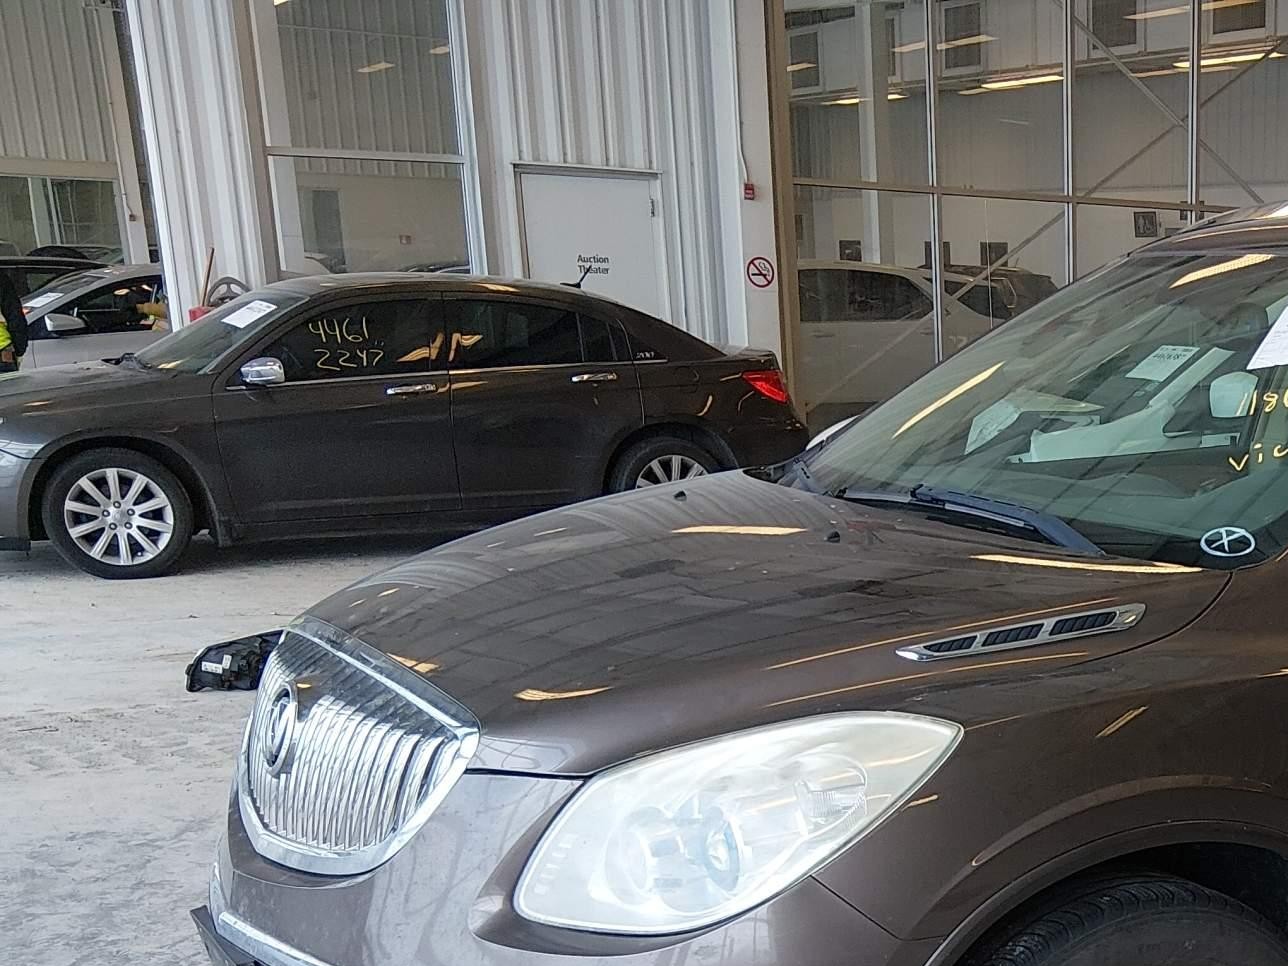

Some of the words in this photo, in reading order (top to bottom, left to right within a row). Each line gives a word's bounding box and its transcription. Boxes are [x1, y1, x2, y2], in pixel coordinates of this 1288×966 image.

[577, 254, 609, 264] Auction
[308, 316, 369, 344] 4461
[313, 348, 384, 371] 2247
